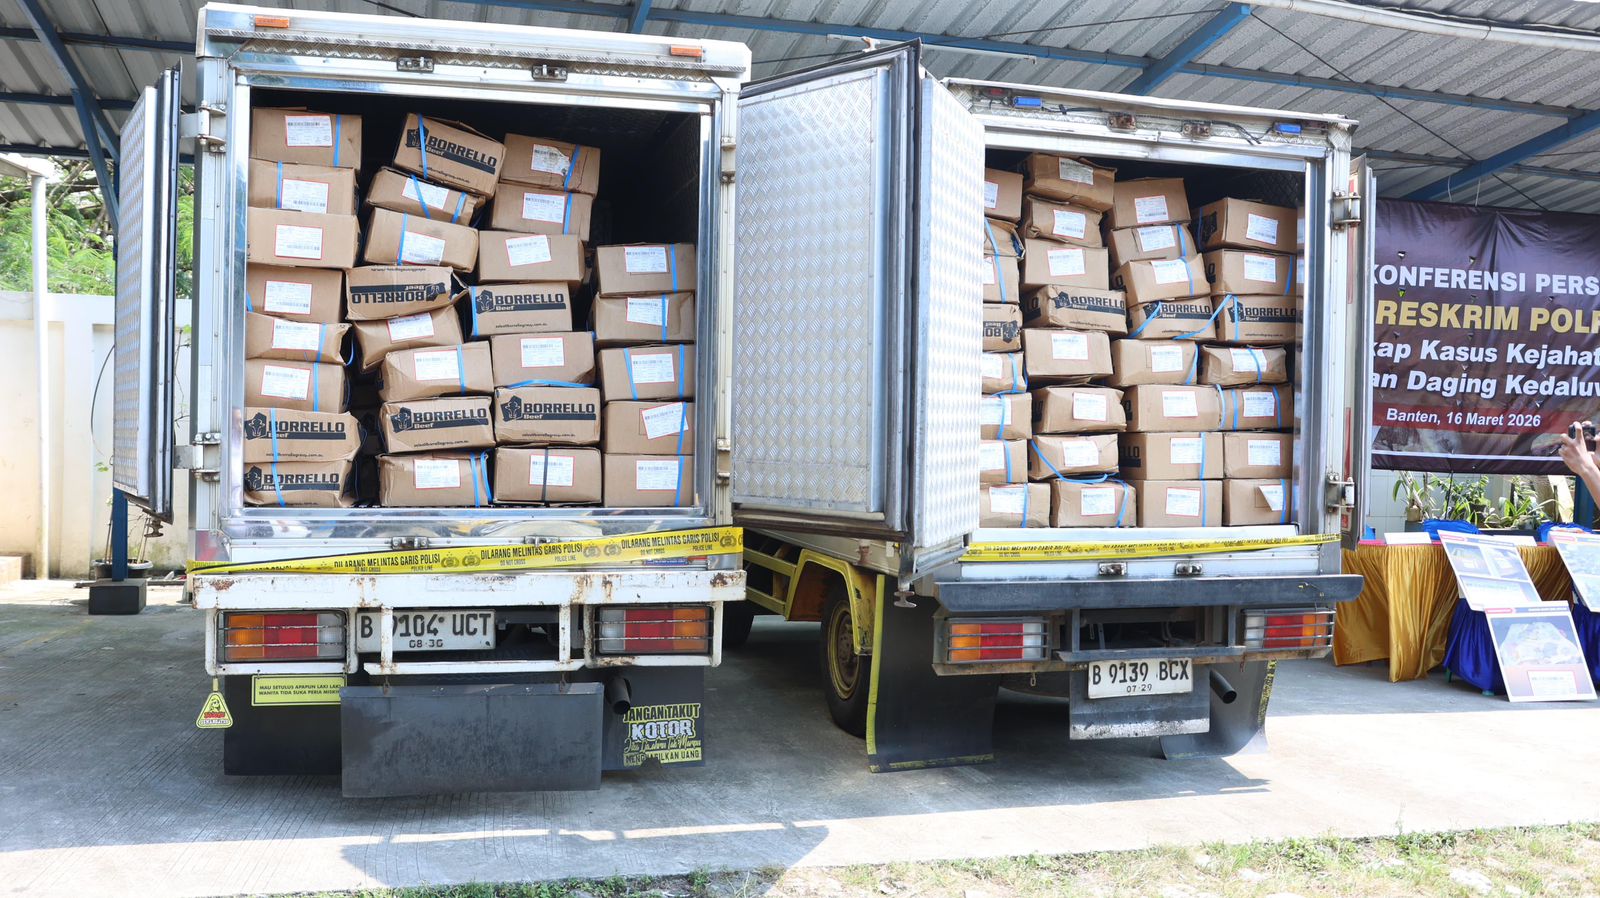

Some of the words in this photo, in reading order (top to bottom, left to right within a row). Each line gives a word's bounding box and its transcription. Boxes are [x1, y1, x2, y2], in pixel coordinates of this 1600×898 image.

[428, 135, 498, 168] BORRELLO
[1536, 274, 1600, 295] PERS
[352, 291, 425, 304] BORRELLO
[495, 293, 565, 305] BORRELLO
[1071, 296, 1125, 310] BORRELLO
[1162, 304, 1211, 314] BORRELLO
[1245, 307, 1297, 317] BORRELLO
[1375, 300, 1519, 330] RESKRIM
[1420, 340, 1498, 362] Kasus
[1407, 370, 1497, 399] Daging
[1505, 374, 1600, 397] Kedalu
[413, 407, 487, 422] BORRELLO
[524, 403, 595, 414] BORRELLO
[1387, 408, 1441, 425] Banten,
[1446, 412, 1462, 424] 16
[1466, 412, 1504, 426] Maret
[1507, 413, 1541, 427] 2026
[621, 537, 651, 549] DILARANG
[652, 535, 681, 547] MELINTAS
[682, 534, 700, 544] GARIS
[701, 532, 719, 543] POLISI
[400, 555, 419, 565] GARIS
[420, 553, 441, 564] POLISI
[481, 548, 511, 560] DILARANG
[512, 546, 543, 558] MELINTAS
[544, 544, 562, 555] GARIS
[563, 542, 582, 553] POLISI
[360, 615, 374, 638] B
[452, 613, 492, 636] UCT
[1093, 664, 1102, 685] B
[1109, 662, 1149, 684] 9139
[1159, 660, 1189, 681] BCX
[631, 720, 693, 740] KOTOR
[681, 749, 699, 759] UANG
